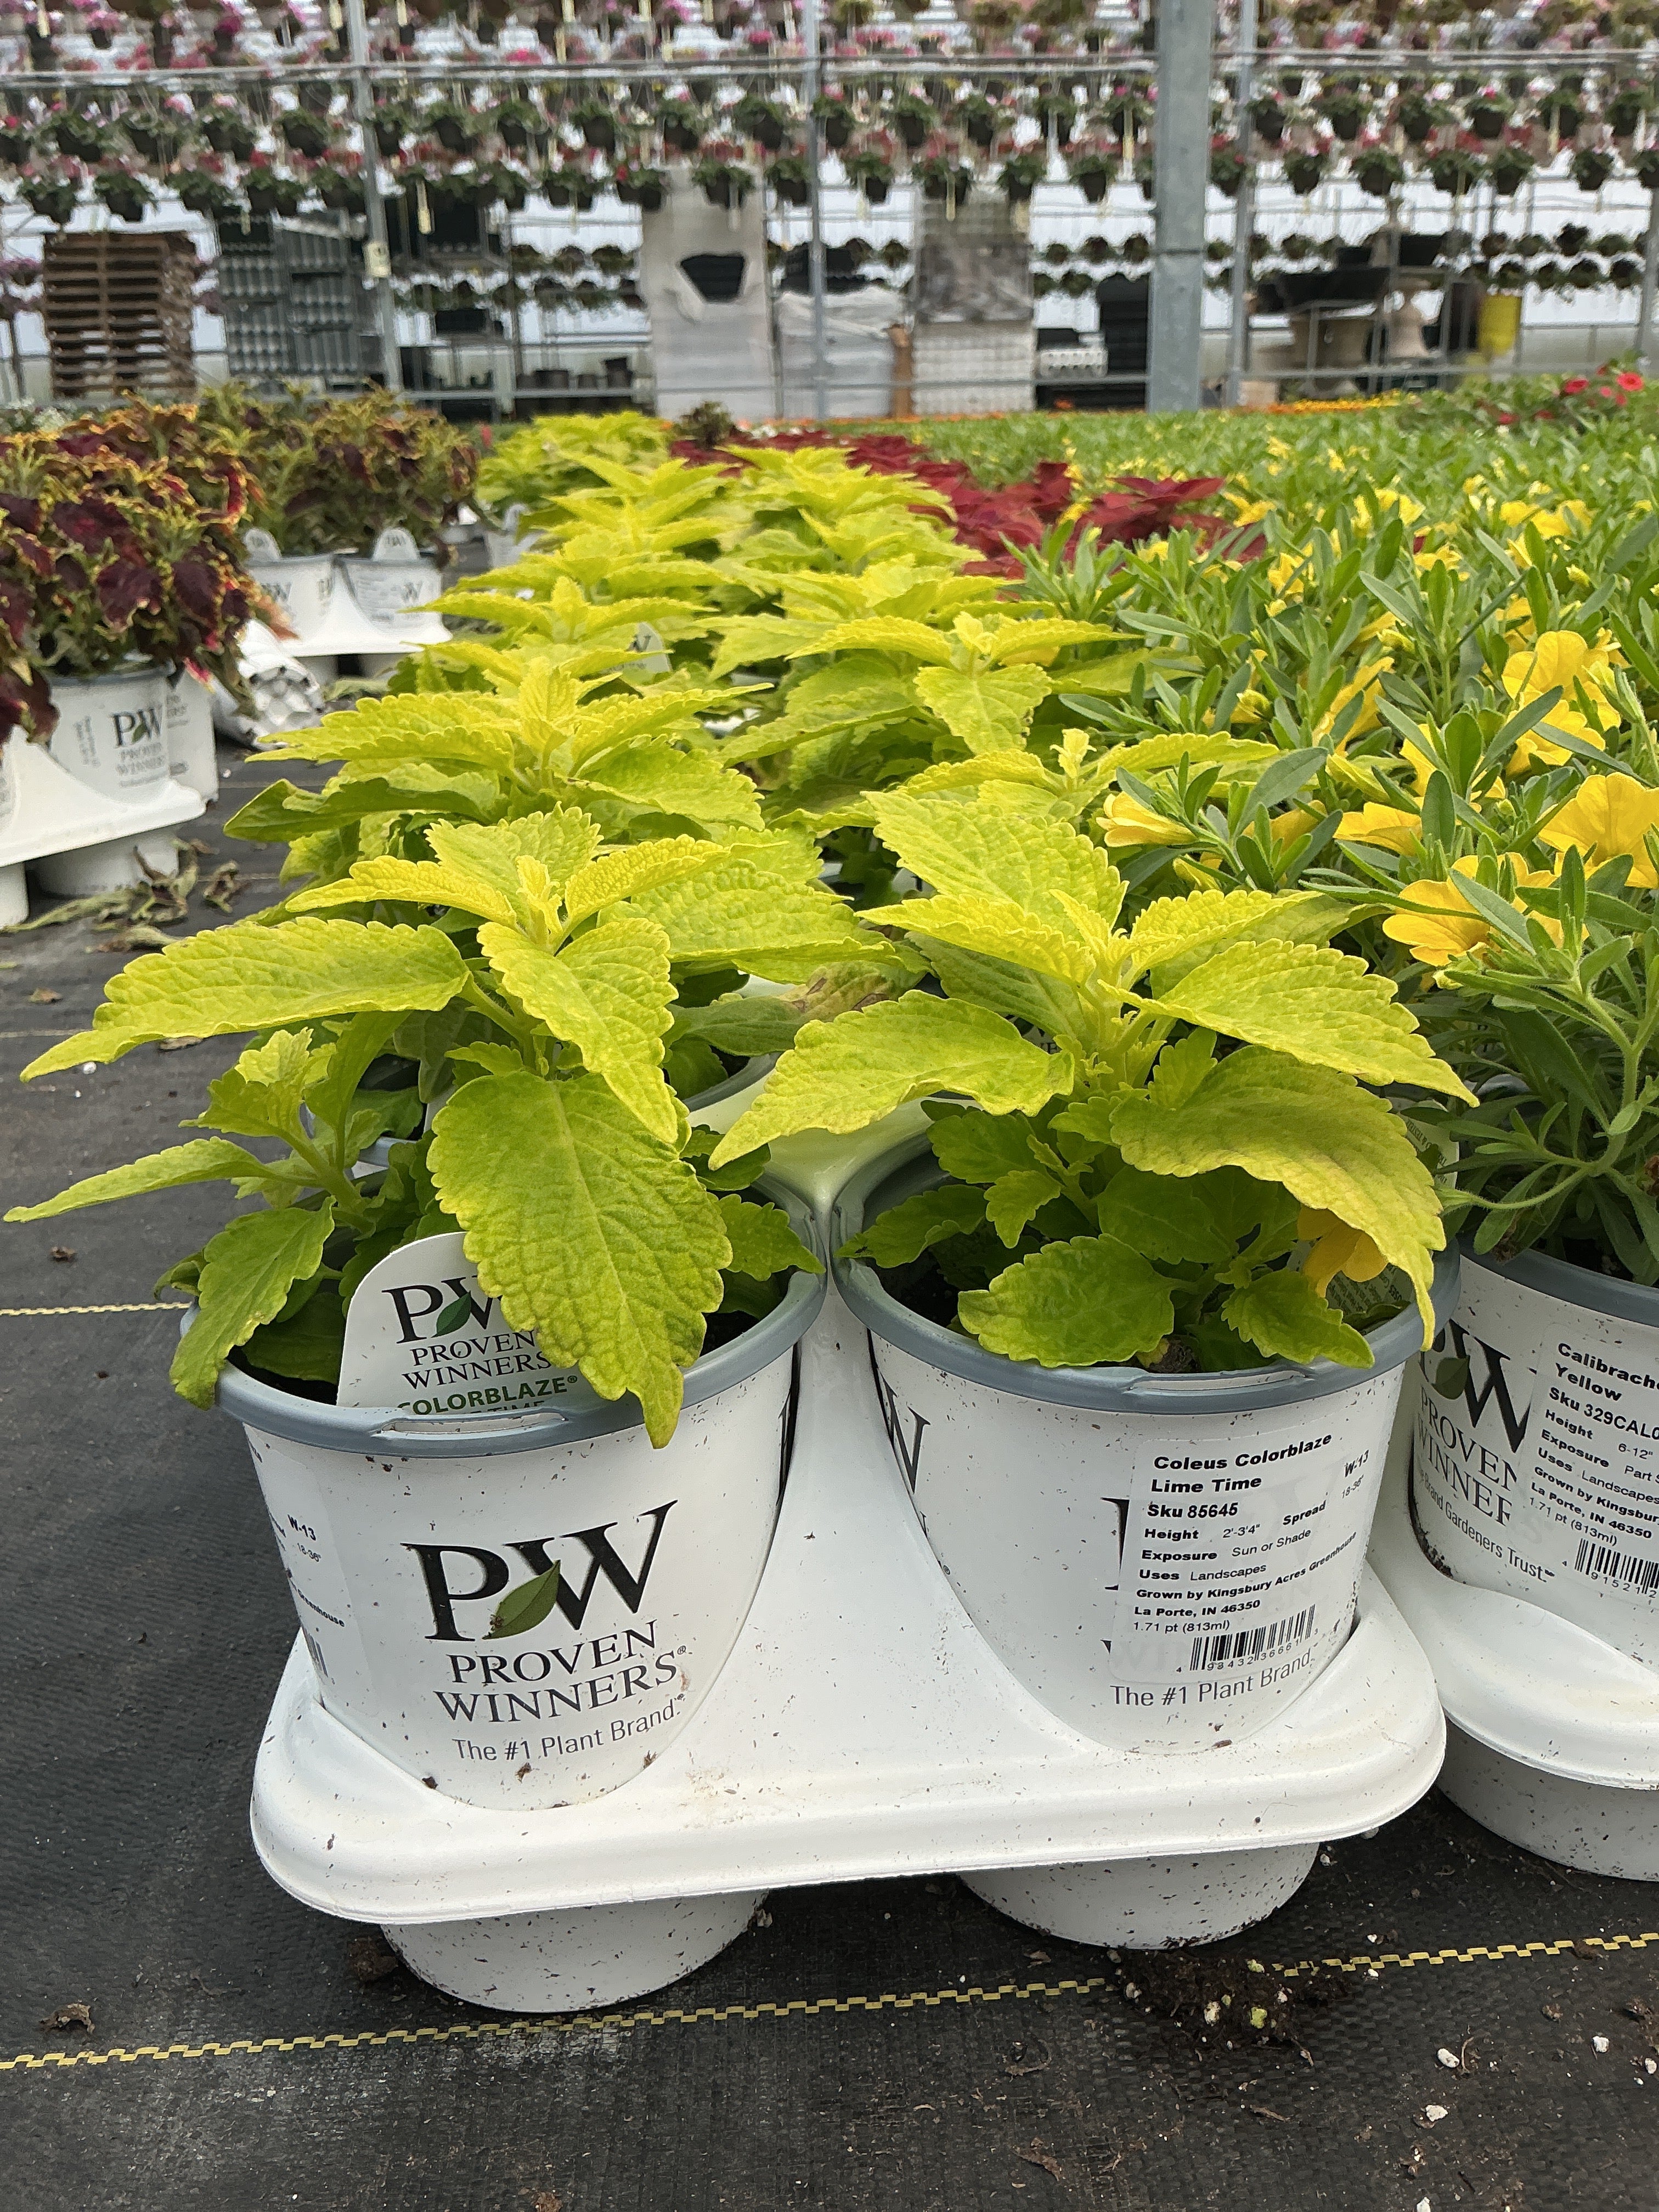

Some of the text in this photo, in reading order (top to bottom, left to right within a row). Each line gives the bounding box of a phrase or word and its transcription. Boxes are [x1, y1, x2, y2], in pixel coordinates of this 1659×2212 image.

[410, 1330, 535, 1367] PROVEN
[1558, 1342, 1659, 1390] Calibrach
[402, 1351, 552, 1390] WINNERS
[1555, 1362, 1622, 1401] Yellow
[1549, 1386, 1580, 1412] Sku
[1154, 1434, 1332, 1470] Coleus Colorblaze
[1545, 1408, 1654, 1460] Height 6-12"
[1541, 1429, 1652, 1481] Exposure Part
[1151, 1477, 1262, 1493] Lime Time
[1538, 1447, 1659, 1505] Uses Landscapes
[1147, 1502, 1239, 1519] Sku 85645
[1531, 1482, 1652, 1539] La Porte, IN 46350
[1534, 1466, 1659, 1526] Grown by Kingsbur
[1144, 1528, 1199, 1542] Height
[1283, 1499, 1327, 1526] Spread
[1445, 1502, 1503, 1559] Gardeners
[1530, 1497, 1617, 1547] 1.71 pt (813ml)
[1141, 1529, 1311, 1563] Exposure Sun or Shade
[400, 1499, 679, 1642] PW
[1136, 1589, 1183, 1599] Grown
[1187, 1592, 1204, 1601] by
[1207, 1580, 1272, 1598] Kingsbury
[1274, 1567, 1306, 1585] Acres
[1139, 1564, 1267, 1581] Uses Landscapes
[1133, 1620, 1230, 1634] 1.71 pt (813ml)
[1135, 1599, 1261, 1618] La Porte, IN 46350
[445, 1619, 657, 1684] PROVEN
[1110, 1685, 1154, 1706] The
[1161, 1686, 1187, 1706] #1
[1199, 1675, 1254, 1702] Plant
[452, 1738, 496, 1760] The
[504, 1740, 531, 1760] #1
[541, 1729, 604, 1757] Plant
